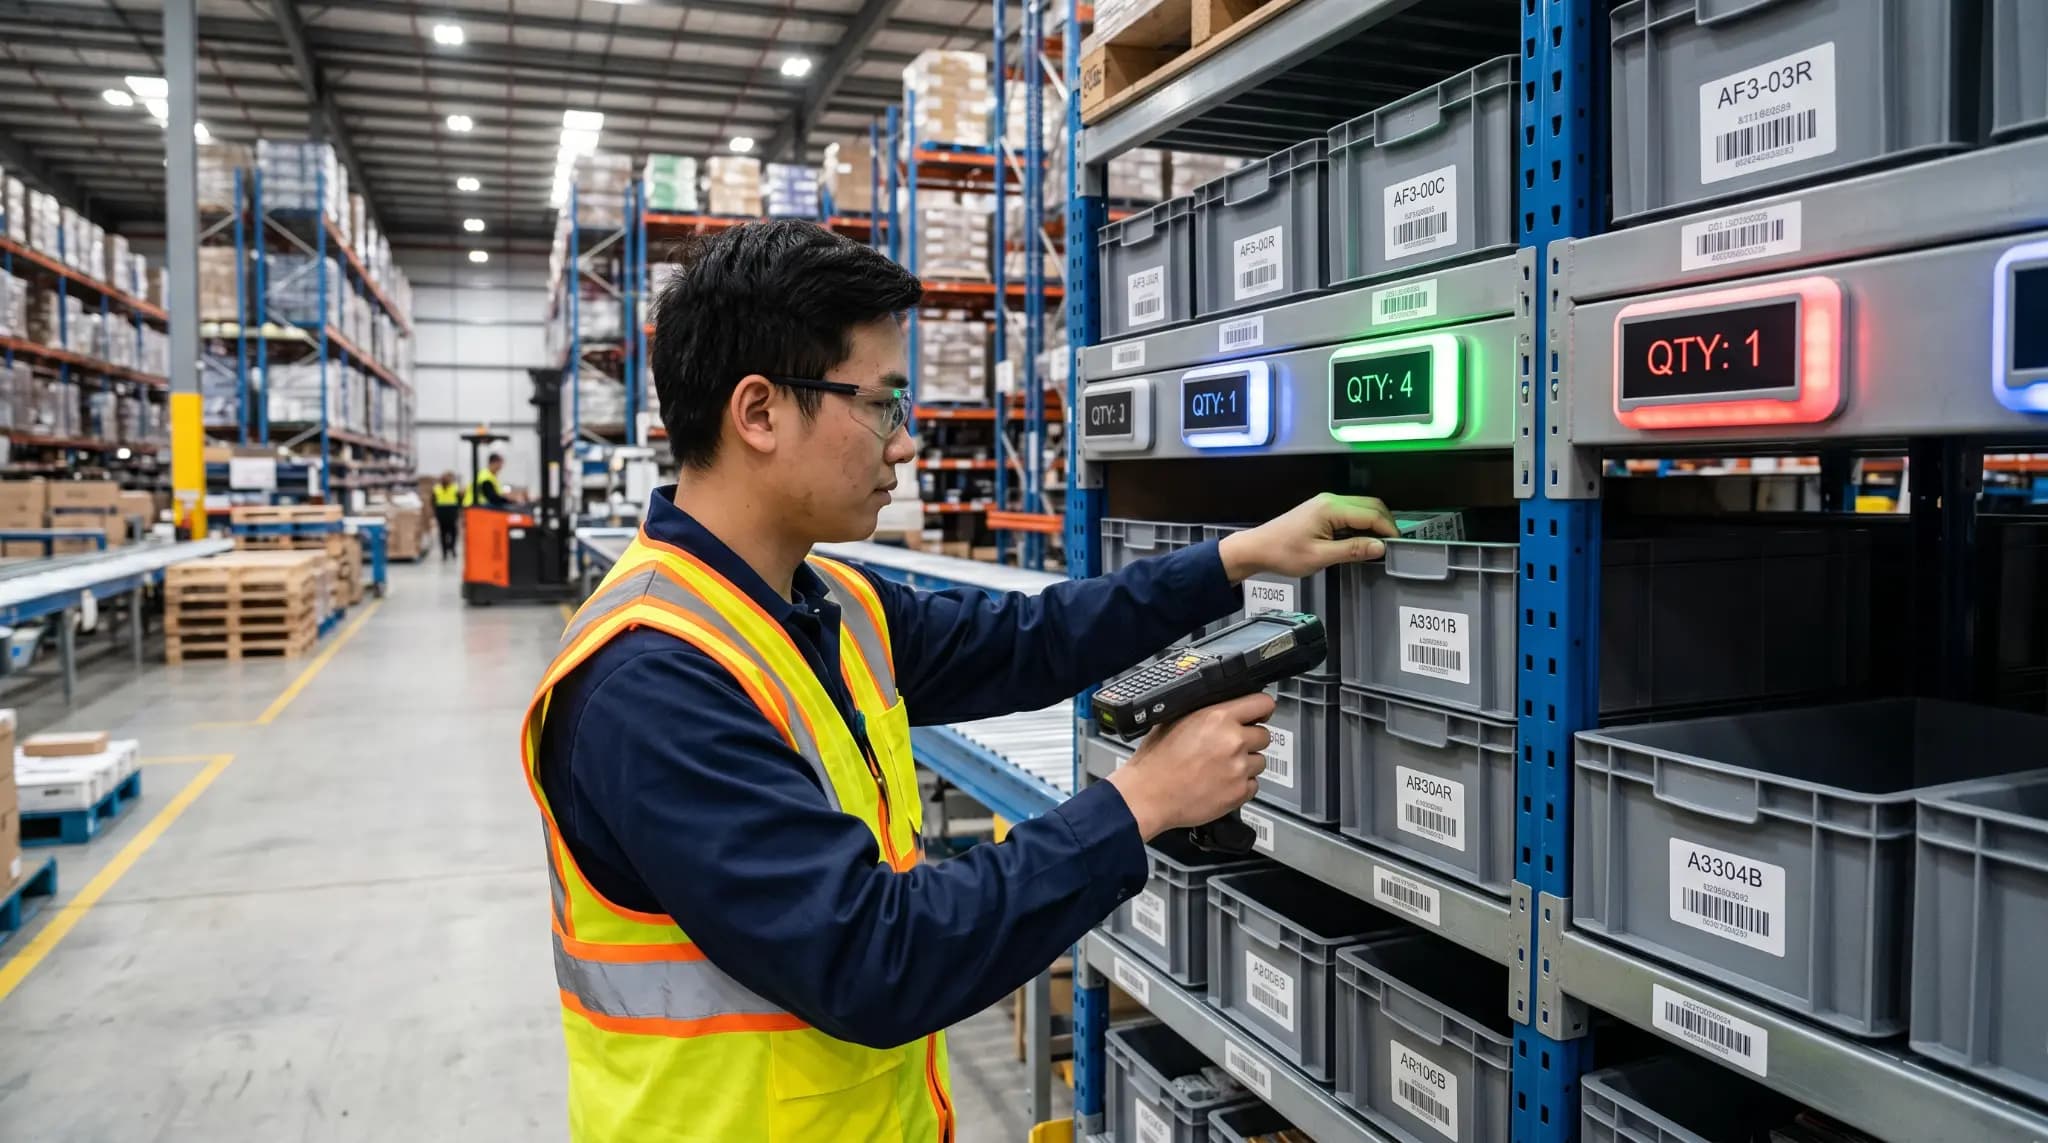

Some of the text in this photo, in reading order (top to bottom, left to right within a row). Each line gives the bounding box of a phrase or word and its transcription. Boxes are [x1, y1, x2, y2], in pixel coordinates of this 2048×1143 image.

[1717, 60, 1813, 110] AF3-03R
[1393, 176, 1446, 208] AF3-00C
[1647, 329, 1760, 376] QTY: 1
[1192, 390, 1236, 417] QTY: 1
[1347, 370, 1414, 404] QTY: 4
[1091, 404, 1116, 427] QTY:
[1409, 613, 1457, 634] A3301B
[1687, 850, 1763, 888] A3304B
